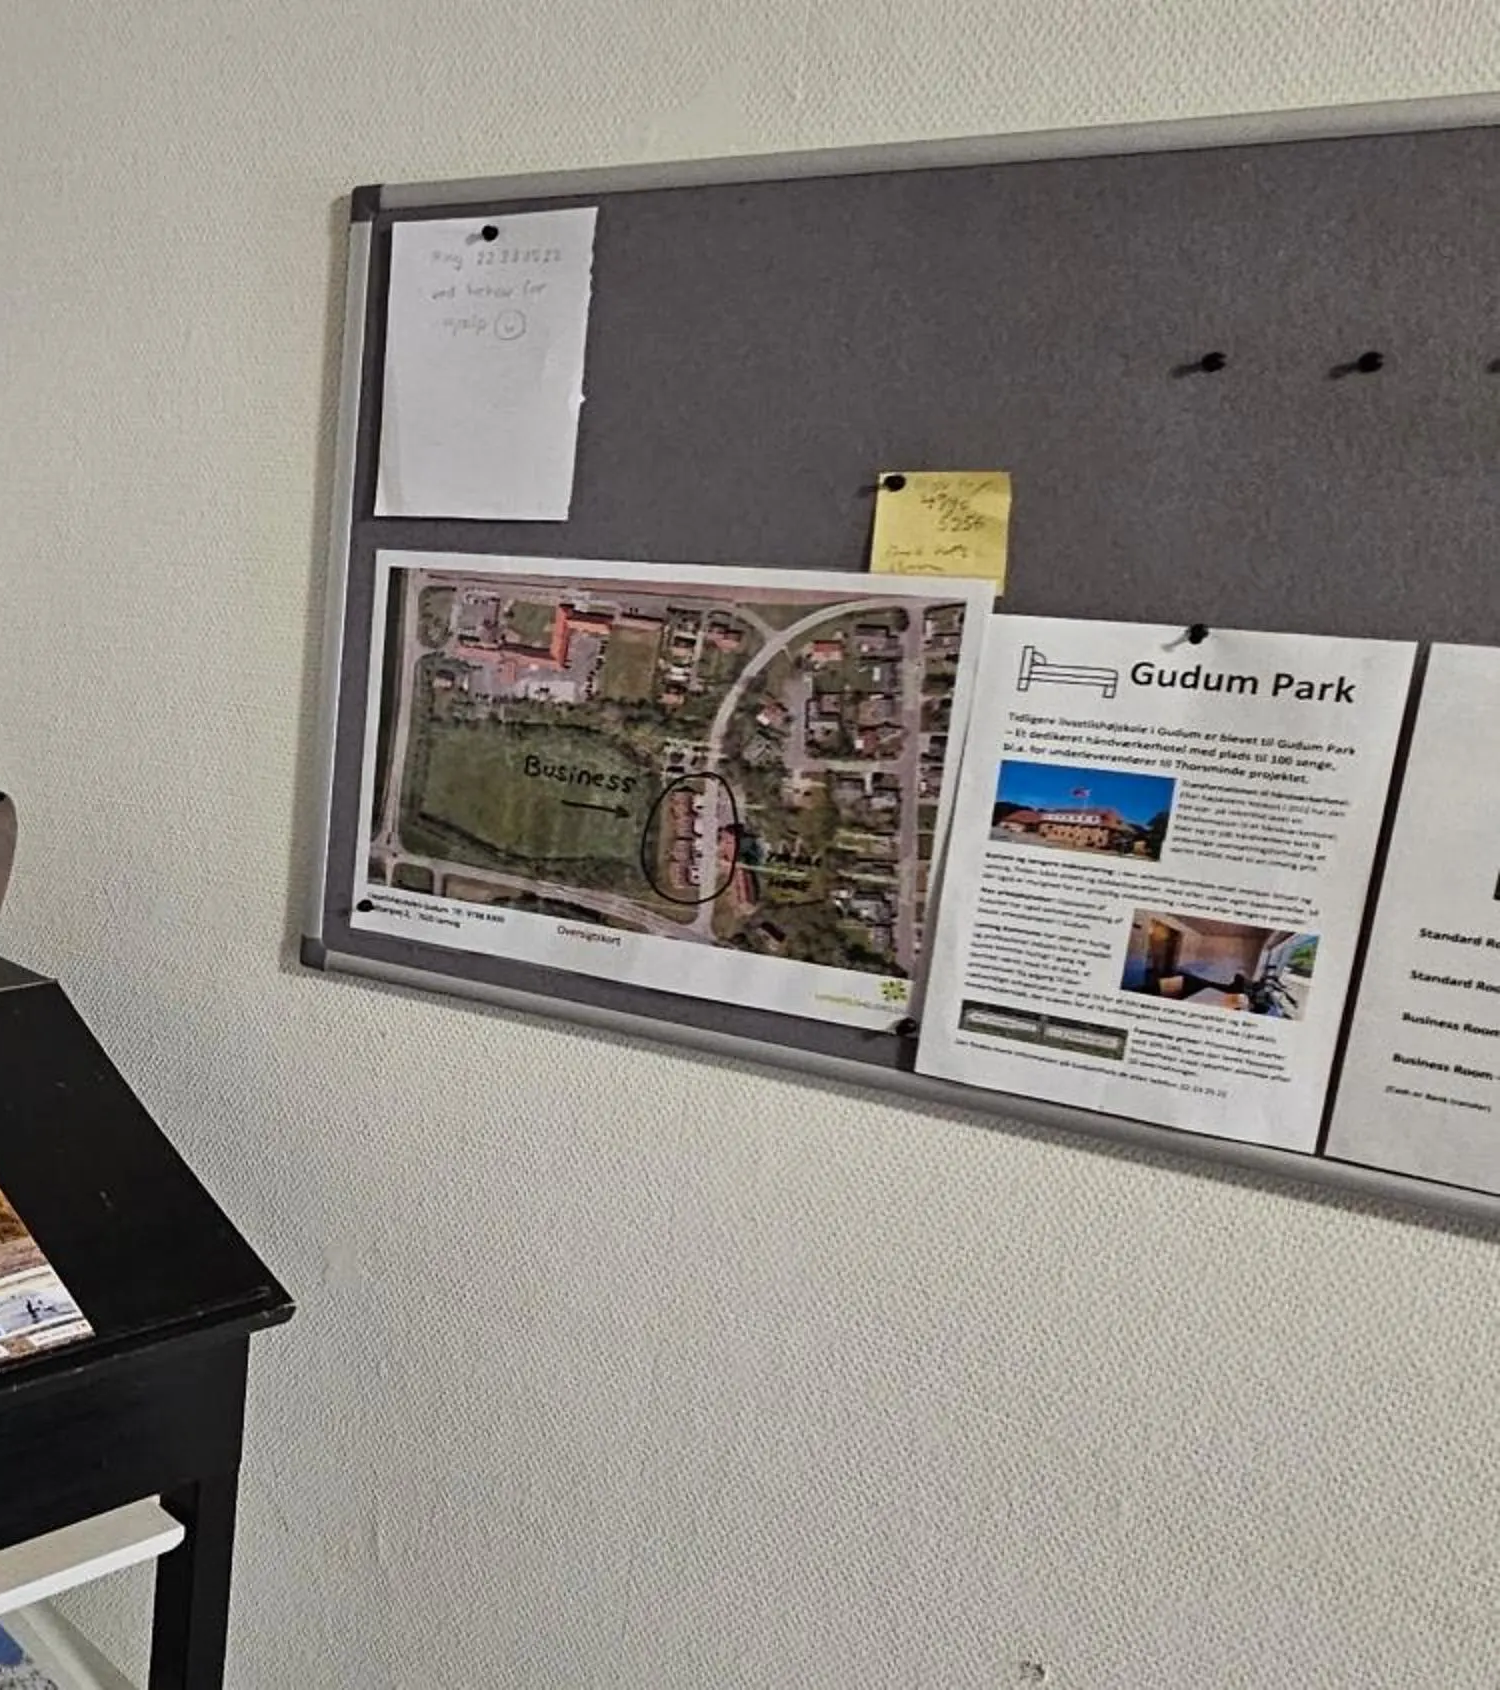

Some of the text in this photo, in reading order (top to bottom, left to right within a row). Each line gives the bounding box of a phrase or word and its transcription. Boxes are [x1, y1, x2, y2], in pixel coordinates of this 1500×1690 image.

[1130, 661, 1356, 704] Gudum Park
[1008, 711, 1056, 725] Tidligere
[1157, 727, 1201, 739] Gudum
[1204, 732, 1218, 741] er
[1261, 737, 1275, 747] til
[1277, 739, 1324, 752] Gudum
[1326, 743, 1356, 756] Park
[1189, 746, 1217, 758] med
[1255, 753, 1267, 763] til
[1271, 754, 1293, 766] 100
[523, 753, 638, 794] Business
[1175, 759, 1246, 777] Thorsminde
[1419, 927, 1482, 946] Standard
[1409, 969, 1473, 989] Standard
[1402, 1011, 1460, 1031] Business
[1392, 1052, 1493, 1081] Business Room
